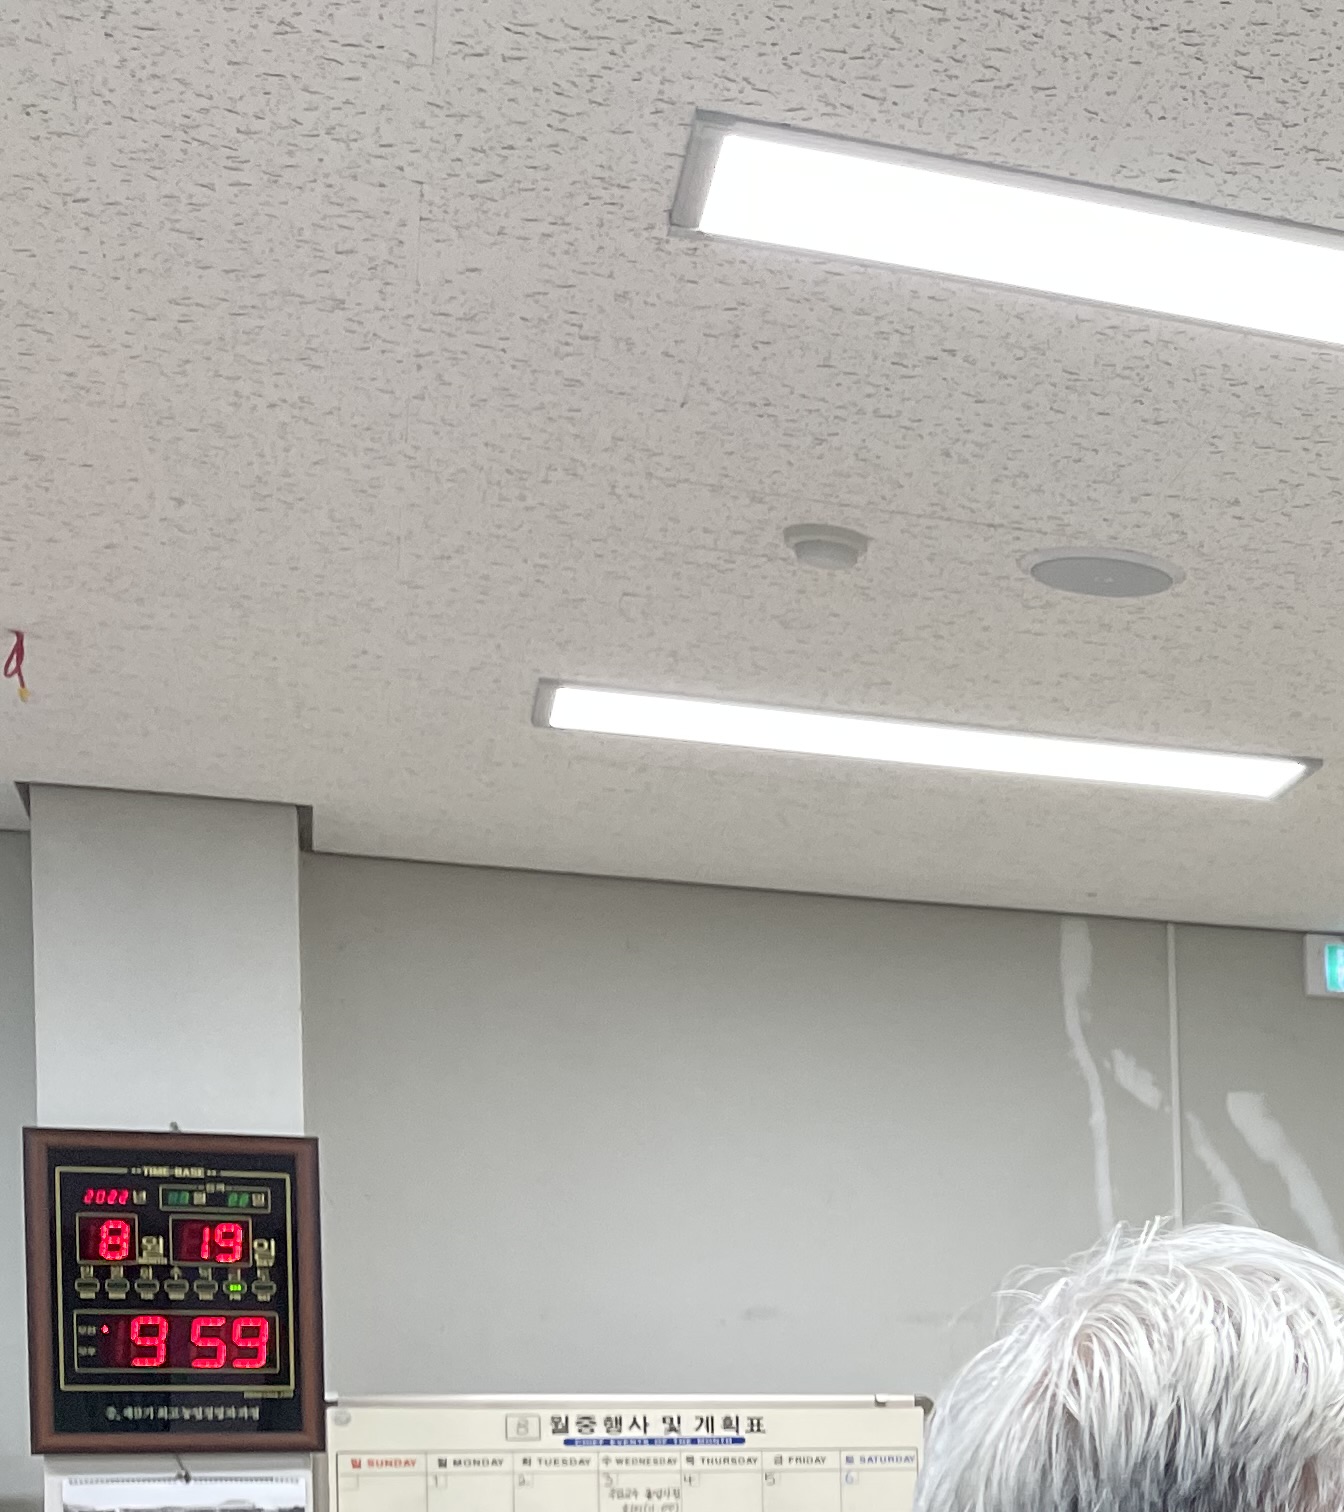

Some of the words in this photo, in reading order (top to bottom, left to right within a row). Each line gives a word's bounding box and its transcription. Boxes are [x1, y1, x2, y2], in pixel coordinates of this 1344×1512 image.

[84, 1188, 129, 1205] 2022
[99, 1219, 131, 1261] 8
[138, 1235, 168, 1264] 월
[200, 1222, 243, 1263] 19
[131, 1315, 168, 1367] 9
[190, 1316, 269, 1369] 59
[550, 1414, 650, 1435] 월중행사
[662, 1414, 682, 1435] 및
[694, 1414, 767, 1435] 계획표
[366, 1458, 417, 1468] SUNDAY
[452, 1457, 504, 1468] MONDAY
[536, 1457, 592, 1467] TUESDAY
[615, 1456, 679, 1466] WEDNESDAY
[700, 1455, 759, 1465] THURSDAY
[788, 1455, 827, 1465] FRIDAY
[859, 1455, 916, 1464] SATURDAY
